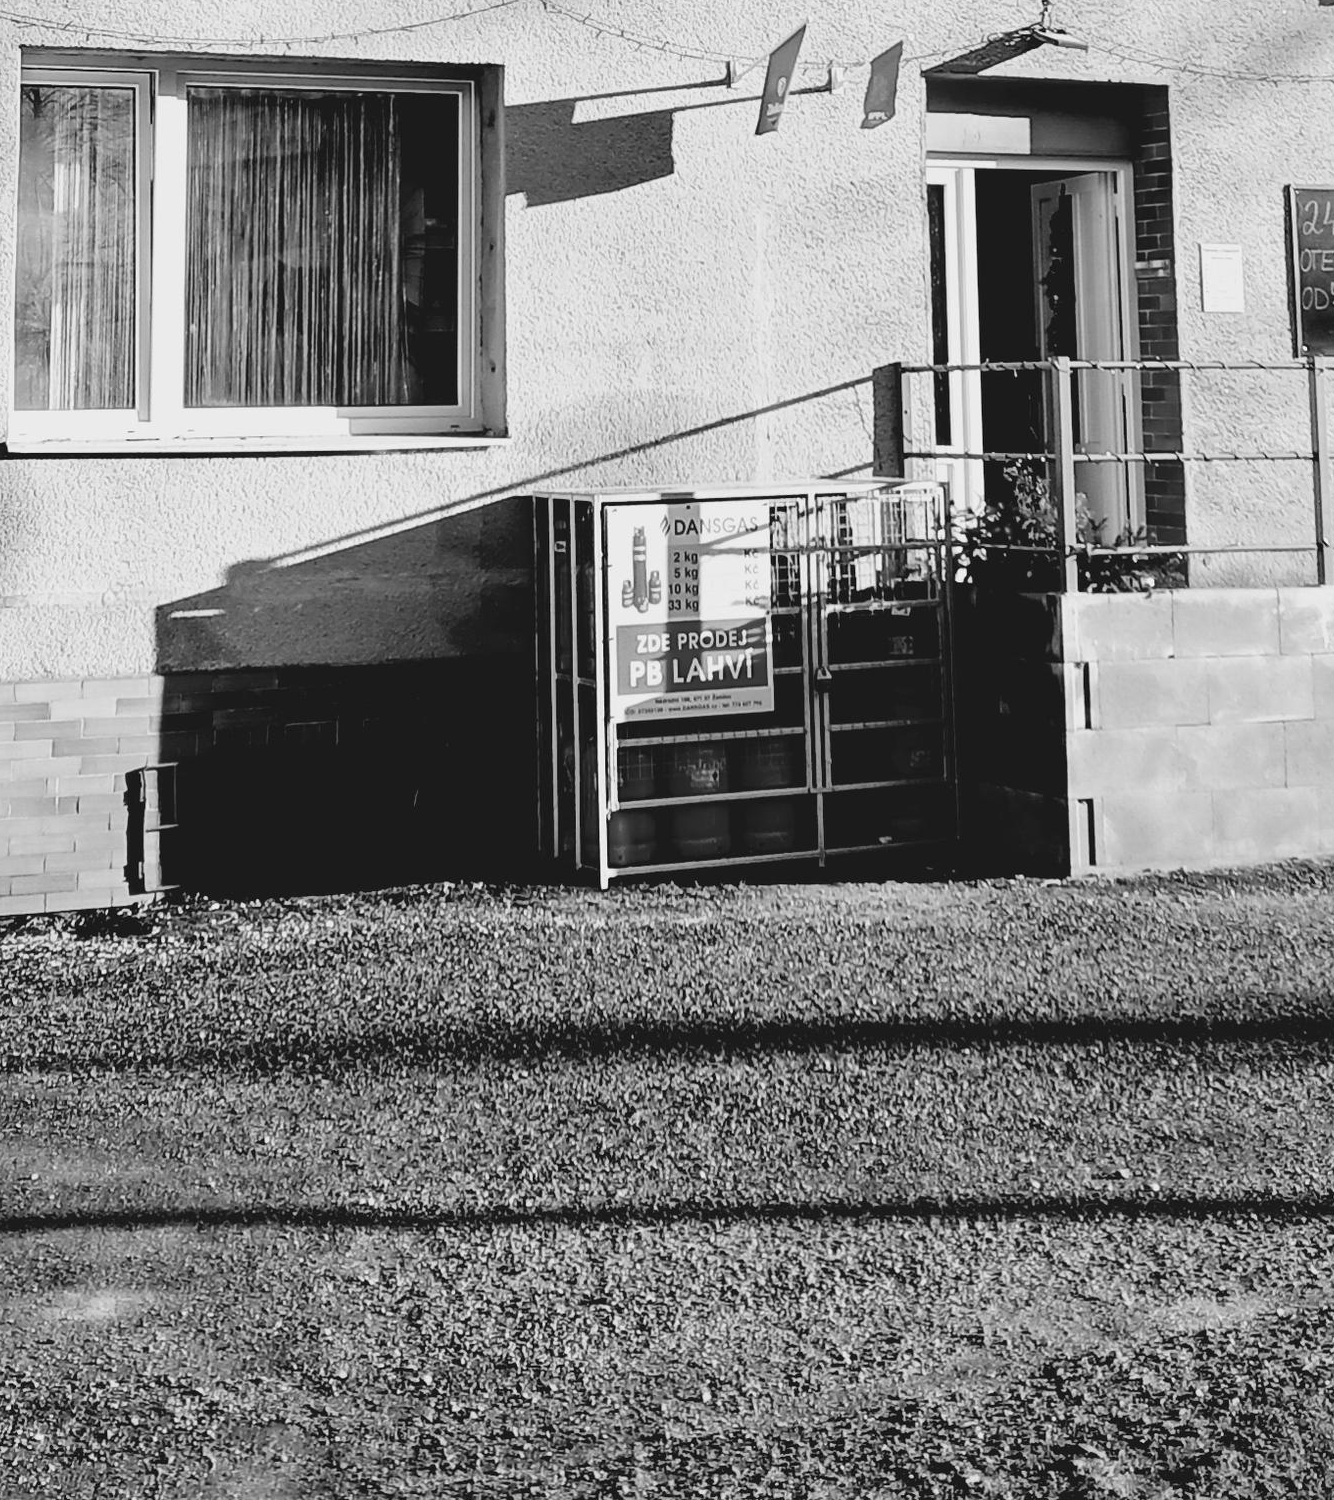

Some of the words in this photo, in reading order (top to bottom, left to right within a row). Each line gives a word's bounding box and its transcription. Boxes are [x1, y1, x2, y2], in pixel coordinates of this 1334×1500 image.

[1302, 286, 1329, 310] OD
[674, 516, 759, 536] DANSGAS
[674, 552, 680, 563] 2
[684, 551, 698, 564] kg
[674, 568, 681, 578] 5
[684, 567, 699, 580] kg
[669, 584, 681, 594] 10
[685, 583, 699, 595] kg
[669, 600, 681, 610] 33
[685, 599, 699, 612] kg
[636, 633, 670, 654] ZDE
[677, 629, 747, 651] PRODEJ
[629, 660, 663, 688] PB
[672, 647, 754, 684] LAHVÍ
